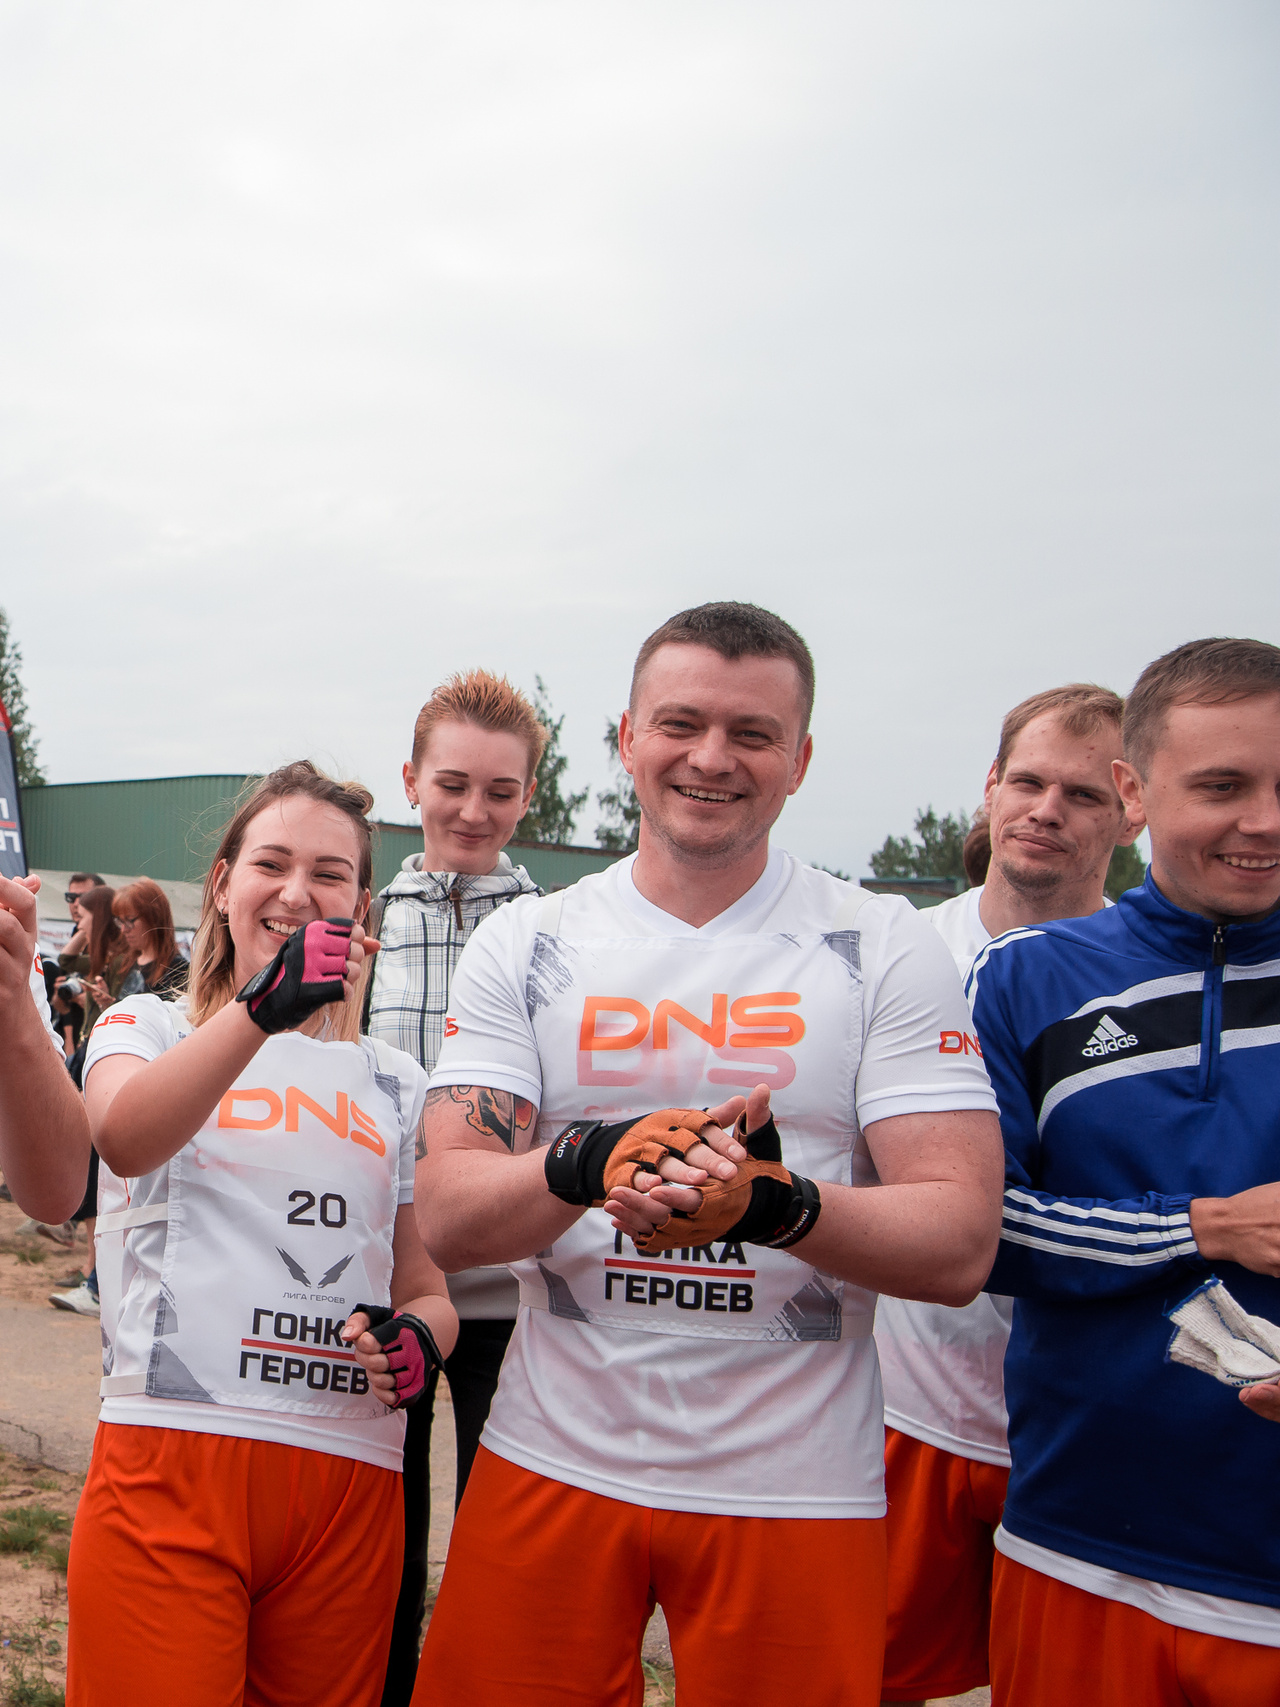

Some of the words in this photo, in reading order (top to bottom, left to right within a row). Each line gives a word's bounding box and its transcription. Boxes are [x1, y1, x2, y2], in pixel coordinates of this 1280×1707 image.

[579, 991, 806, 1051] DNS
[1081, 1034, 1139, 1057] adidas
[217, 1085, 387, 1158] DNS
[556, 1127, 581, 1159] VAMP
[287, 1189, 347, 1229] 20
[282, 1292, 308, 1301] ЛИГА
[310, 1294, 346, 1304] ГЕРОЕВ
[604, 1271, 754, 1313] ГЕРОЕВ
[252, 1307, 356, 1349] ГОНК
[239, 1351, 370, 1396] ГЕРОЕВ
